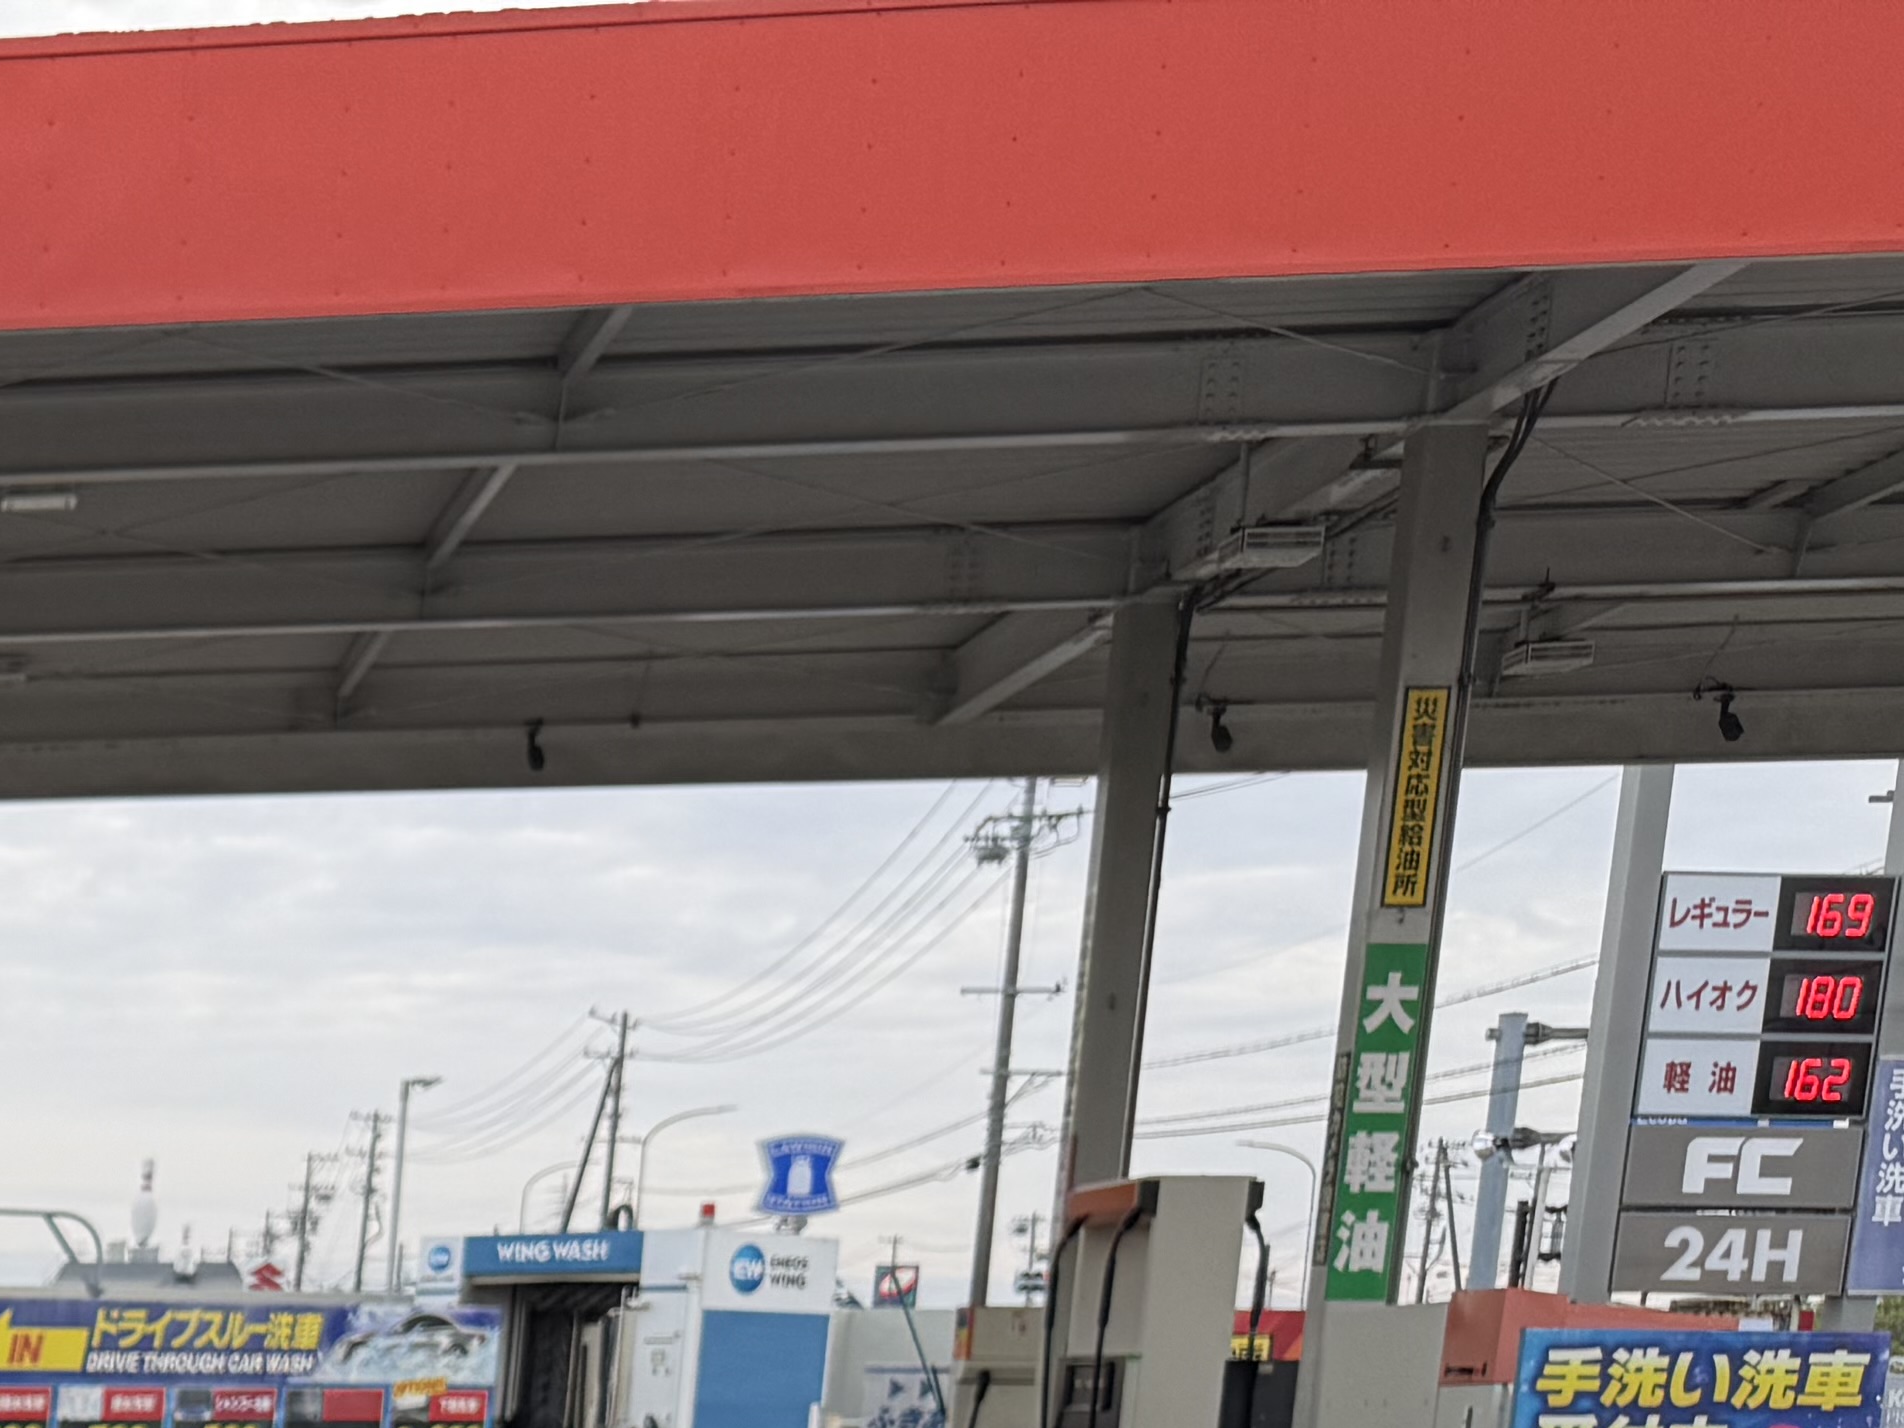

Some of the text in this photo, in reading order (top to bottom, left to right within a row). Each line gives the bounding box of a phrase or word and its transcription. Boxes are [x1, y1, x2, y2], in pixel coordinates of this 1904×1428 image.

[1393, 697, 1438, 897] 災害対応型給油所
[1669, 893, 1875, 937] レギュラー 169
[1660, 976, 1863, 1020] ハイオク 180
[1663, 1058, 1851, 1101] 軽油 162
[1333, 971, 1419, 1273] 大型軽油
[1682, 1137, 1804, 1195] FC
[497, 1239, 610, 1262] WING WASH
[1662, 1226, 1804, 1282] 24H
[770, 1273, 806, 1290] WING
[8, 1332, 44, 1365] IN
[86, 1350, 314, 1374] DRIVE THROUGH CAR WASH
[1535, 1345, 1872, 1411] 手洗い洗車
